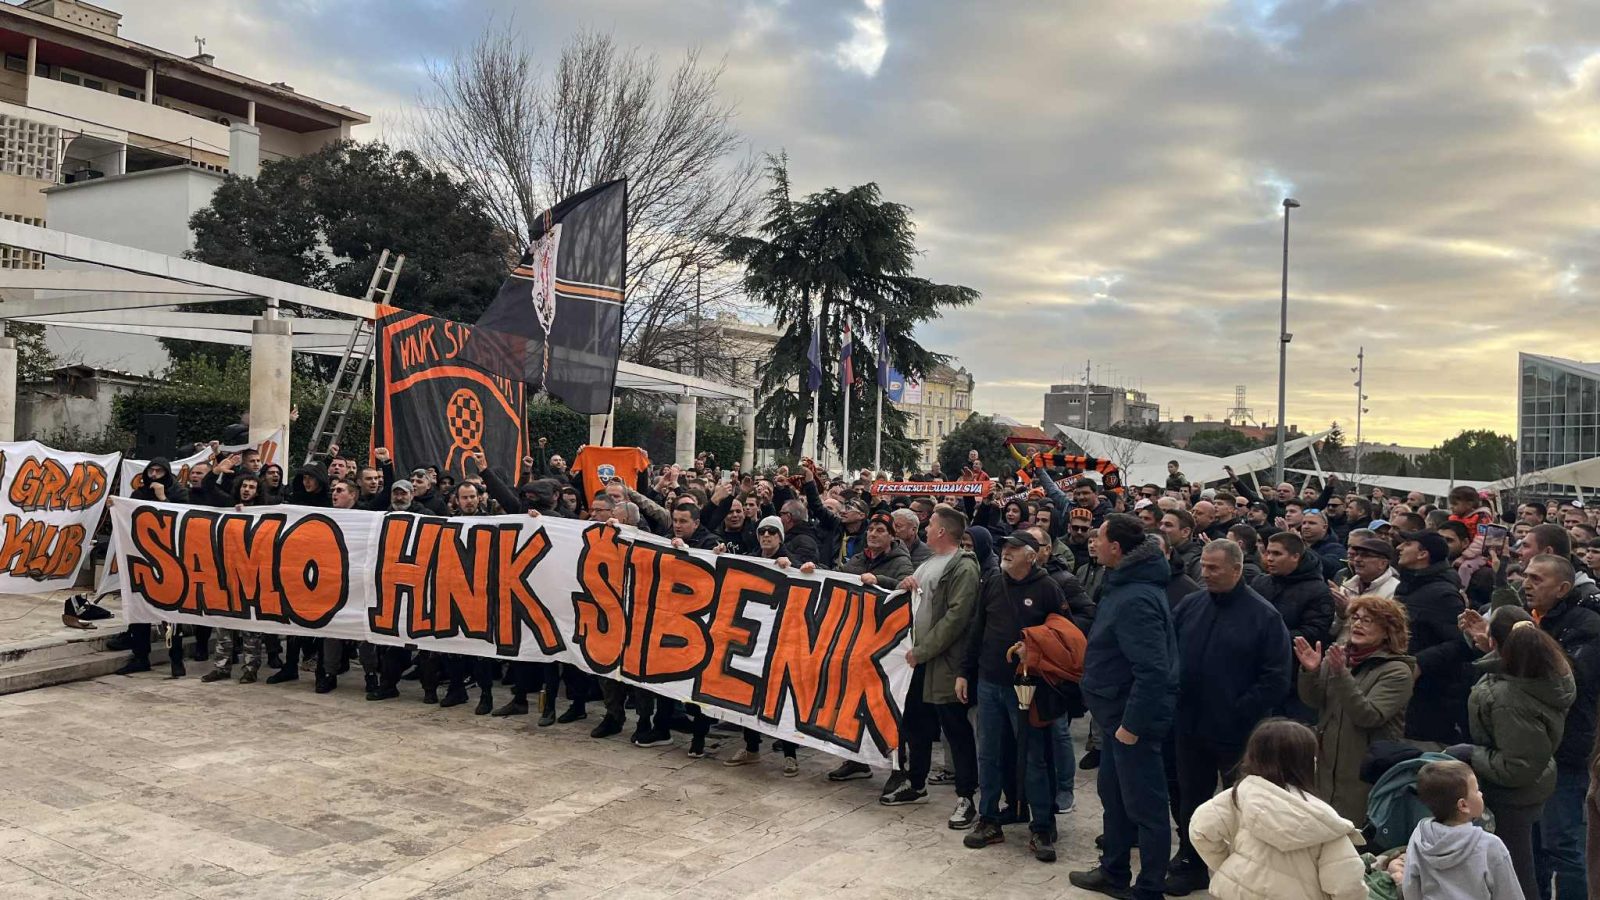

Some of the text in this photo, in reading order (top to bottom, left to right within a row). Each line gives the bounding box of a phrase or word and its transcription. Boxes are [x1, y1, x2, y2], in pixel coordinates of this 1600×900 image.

[9, 455, 108, 512] GRAD
[962, 484, 983, 493] SVA
[0, 514, 86, 581] KLUB
[128, 505, 913, 756] SAMO HNK ŠIBENIK
